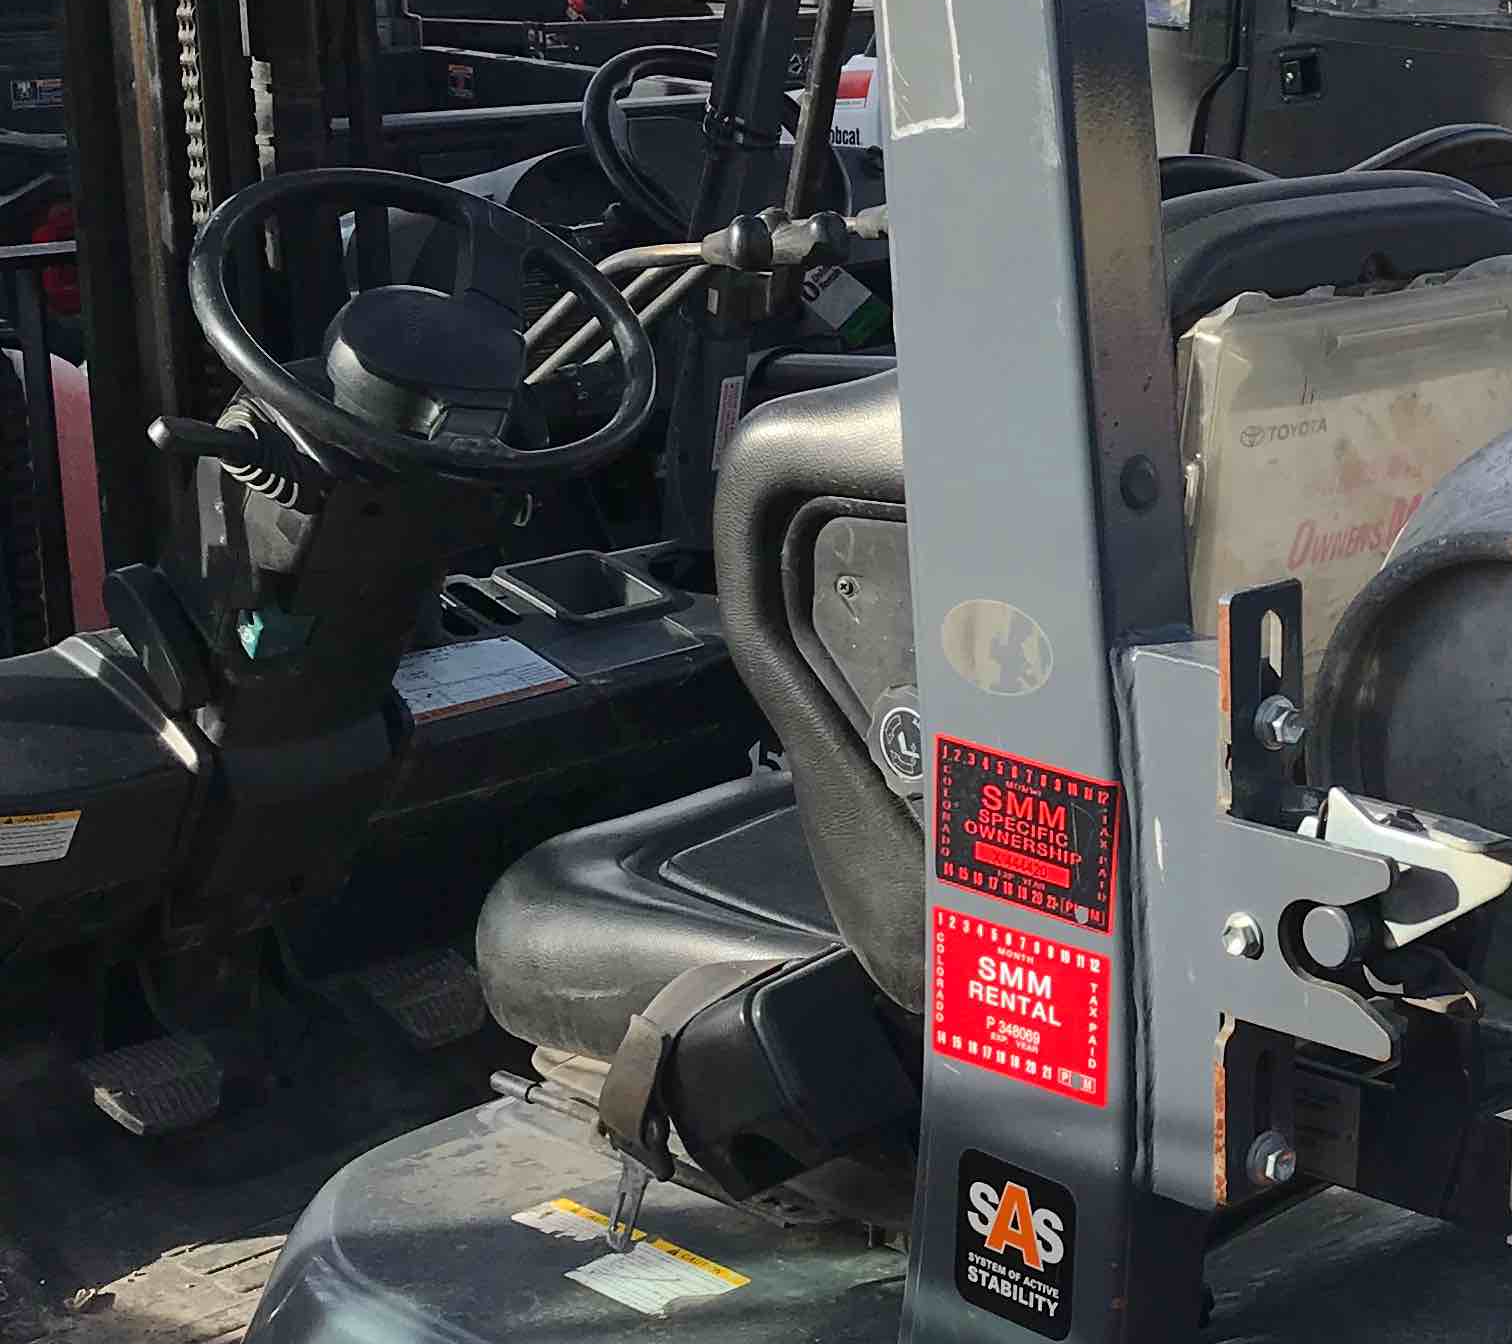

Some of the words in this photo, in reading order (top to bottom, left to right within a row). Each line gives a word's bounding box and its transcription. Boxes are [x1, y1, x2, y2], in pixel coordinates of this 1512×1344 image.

[1267, 417, 1328, 441] TOYOTA
[978, 808, 1069, 848] SPECIFIC
[982, 784, 1067, 831] SMM
[963, 818, 1083, 865] OWNERSHIP
[935, 931, 945, 1023] COLORADO
[977, 956, 1052, 1000] SMM
[1089, 982, 1099, 1018] TAX
[968, 979, 1062, 1027] RENTAL
[1087, 1022, 1098, 1069] PAID
[966, 1179, 1065, 1273] SAS
[966, 1265, 1059, 1318] STABILITY
[967, 1251, 1007, 1277] SYSTEM
[1008, 1269, 1022, 1283] OF
[1022, 1275, 1060, 1300] ACTIVE
